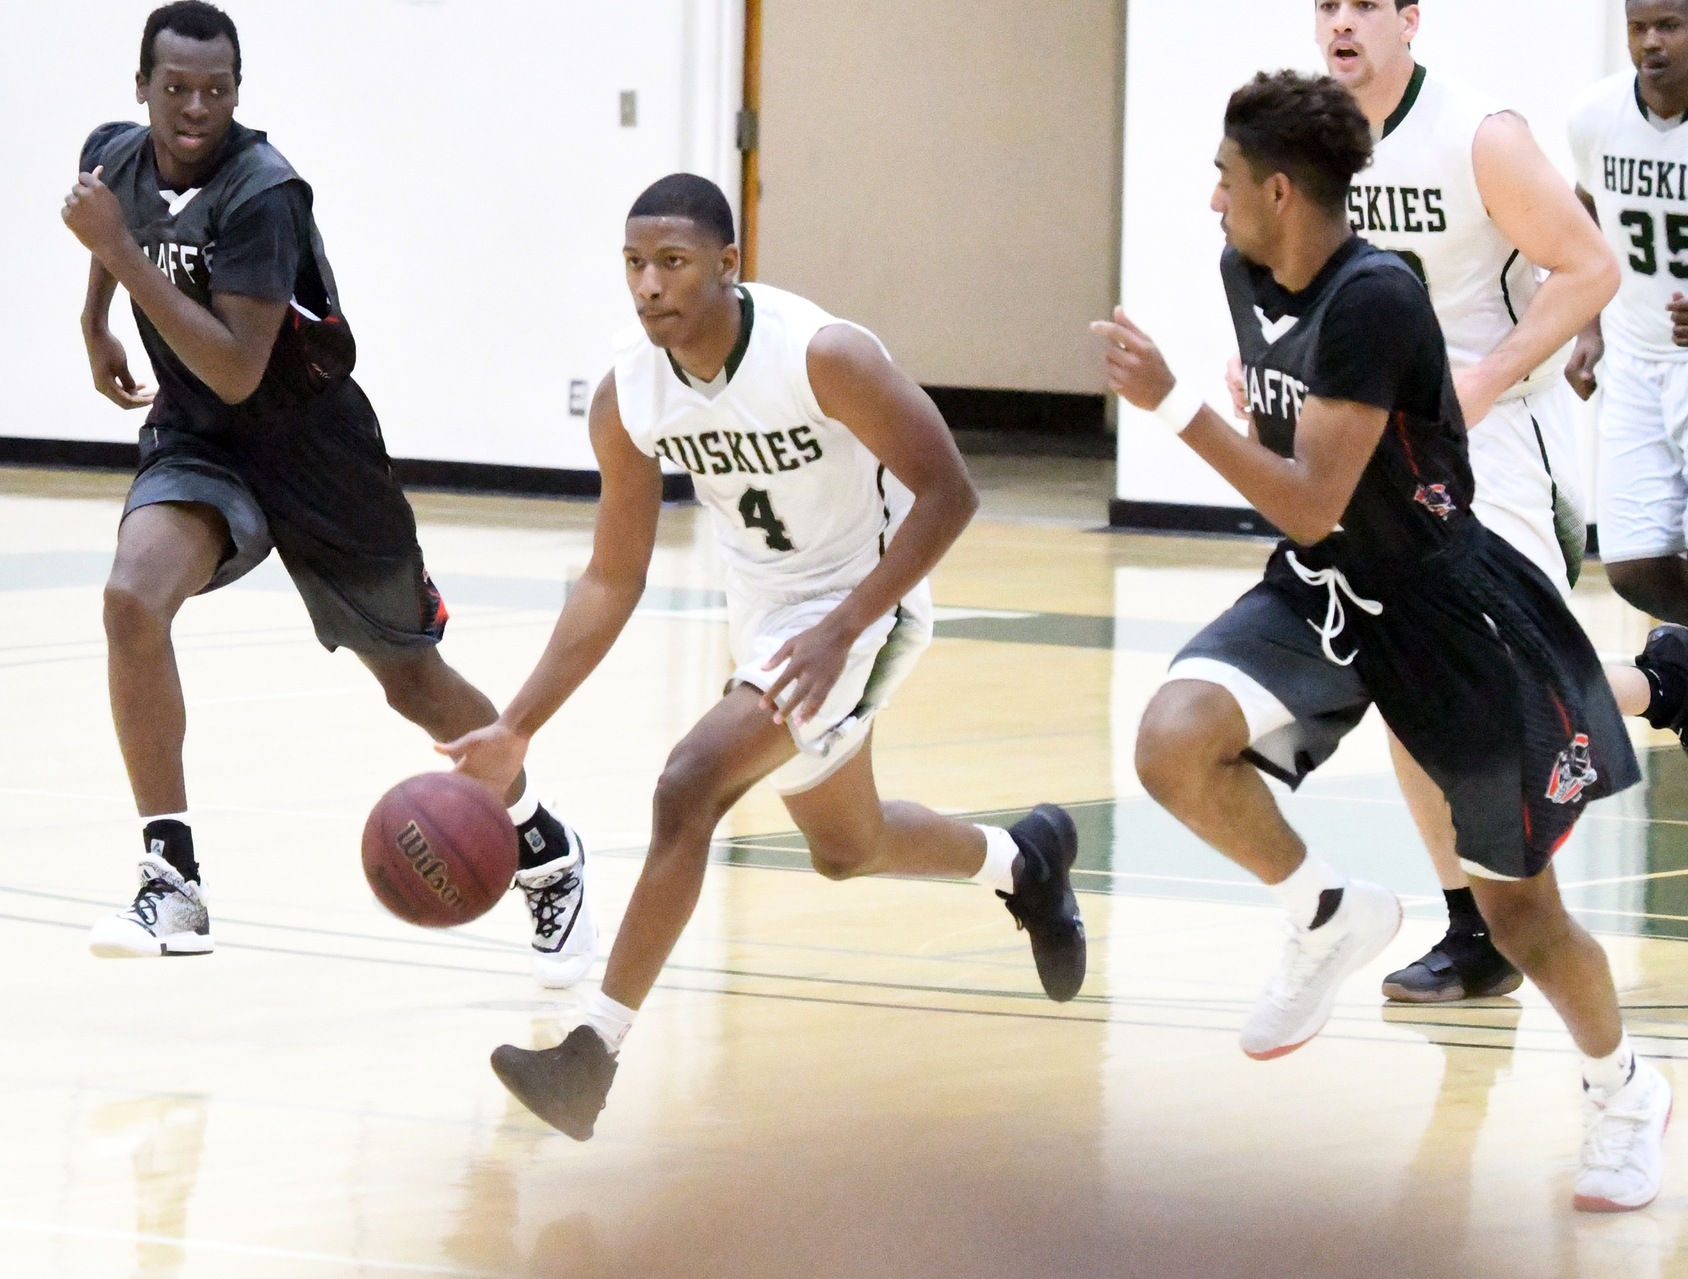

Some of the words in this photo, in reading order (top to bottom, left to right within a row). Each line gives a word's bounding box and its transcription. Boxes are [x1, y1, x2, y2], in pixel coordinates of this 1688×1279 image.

[143, 242, 215, 285] AFF
[1619, 208, 1688, 279] 35
[737, 485, 797, 552] 4
[396, 819, 466, 913] Wilson
